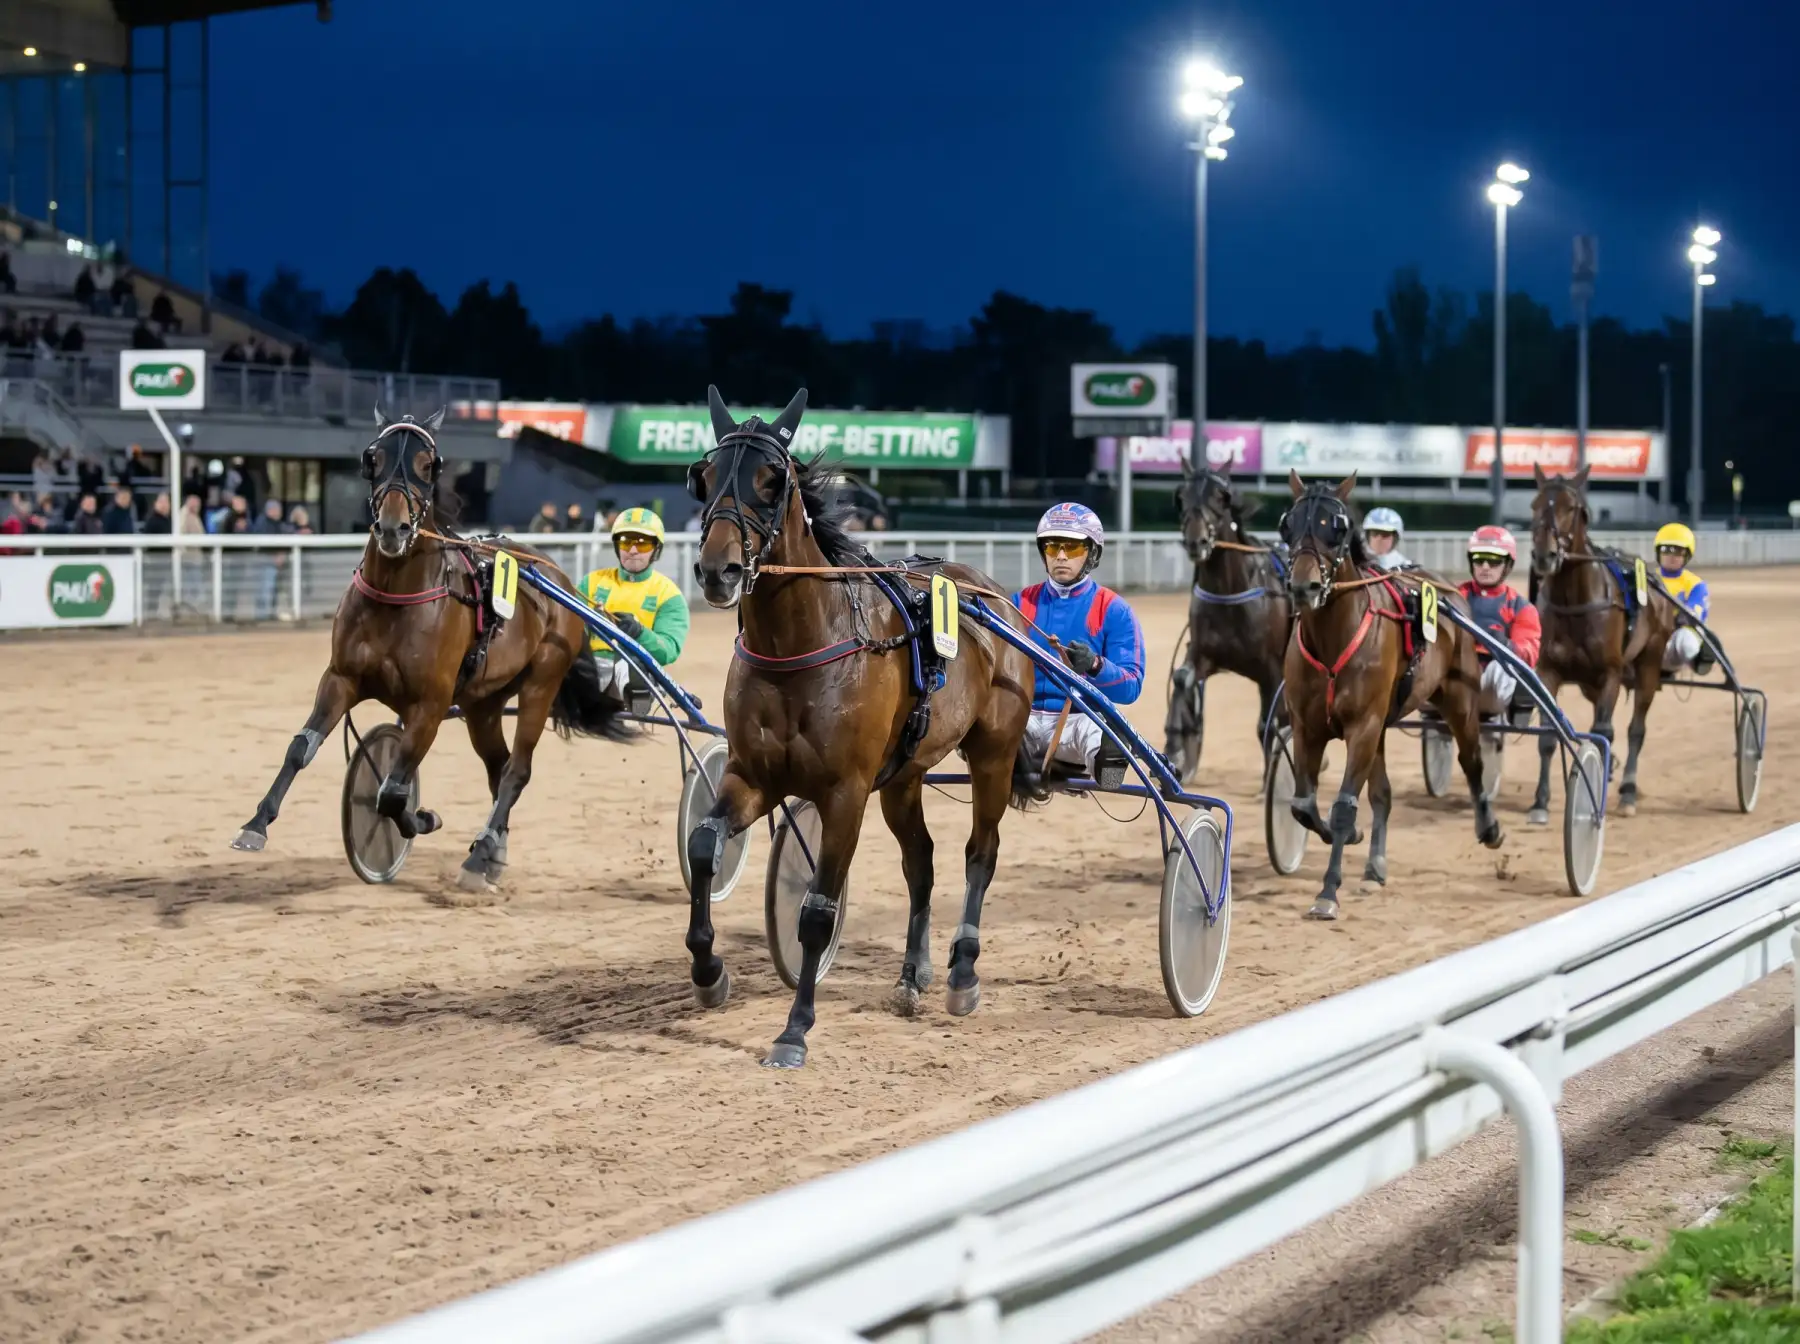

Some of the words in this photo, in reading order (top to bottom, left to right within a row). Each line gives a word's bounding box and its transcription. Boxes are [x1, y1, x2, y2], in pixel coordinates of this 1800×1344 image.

[134, 373, 169, 389] PMU
[52, 581, 89, 605] PMU
[501, 557, 510, 600] 1
[939, 581, 949, 634] 1
[1425, 586, 1435, 625] 2
